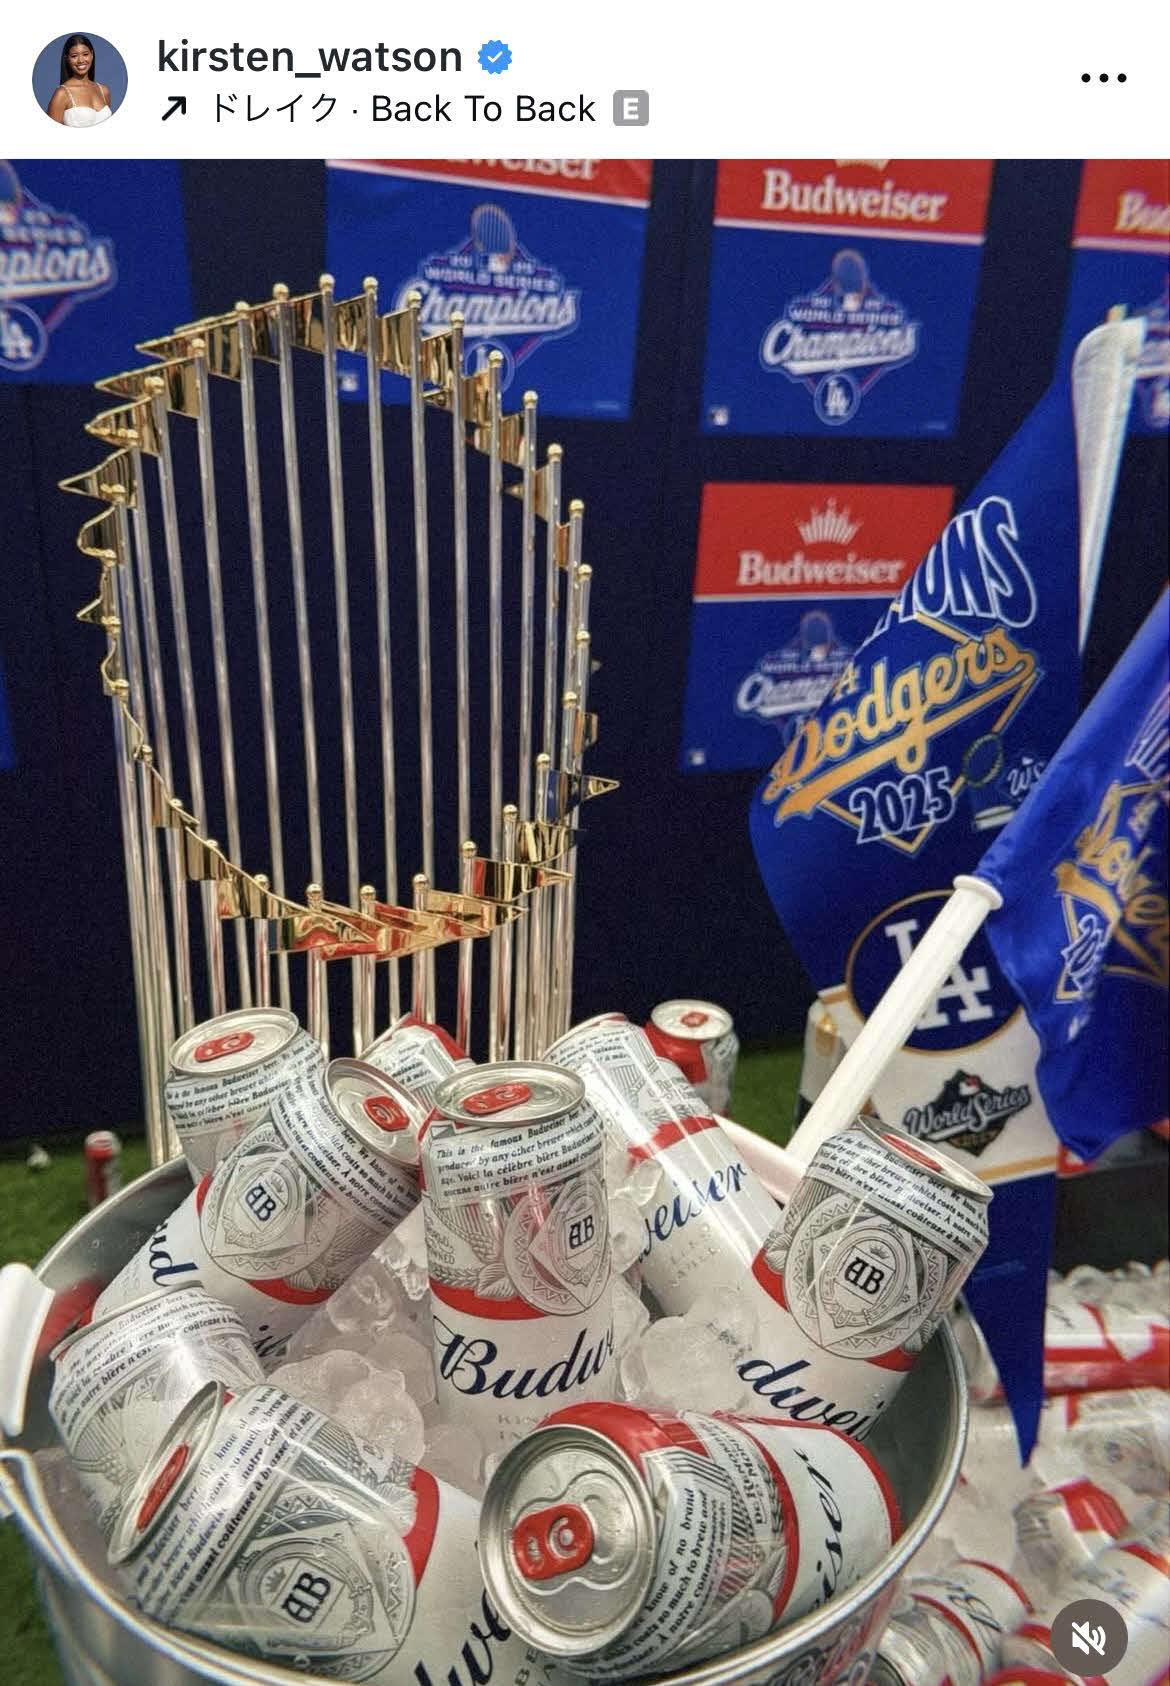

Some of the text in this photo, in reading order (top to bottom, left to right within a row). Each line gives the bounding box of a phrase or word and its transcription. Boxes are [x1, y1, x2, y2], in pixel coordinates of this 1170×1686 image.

[761, 167, 948, 222] Budweiser
[737, 551, 903, 586] Budweiser
[763, 627, 1035, 800] Dodgers
[848, 766, 957, 845] 2025
[222, 1068, 259, 1086] Budweiser
[903, 1087, 1029, 1137] World Series
[341, 1128, 356, 1148] beer.
[437, 1118, 565, 1159] This is the famous Budweiser
[479, 1156, 489, 1166] by
[492, 1153, 509, 1162] any
[511, 1144, 535, 1157] other
[536, 1133, 564, 1149] brewer
[308, 1151, 341, 1189] coûteuse
[342, 1148, 360, 1171] costs
[358, 1168, 368, 1178] so
[367, 1176, 386, 1195] much
[458, 1171, 480, 1181] Voici
[483, 1169, 493, 1177] la
[497, 1159, 533, 1175] célèbre
[536, 1150, 559, 1163] bière
[474, 1181, 500, 1191] autre
[503, 1174, 529, 1186] bière
[532, 1165, 554, 1178] n'est
[869, 1172, 892, 1188] bière
[245, 1183, 277, 1222] AB
[350, 1177, 370, 1197] notre
[881, 1165, 911, 1184] brewer
[912, 1183, 937, 1201] which
[937, 1198, 957, 1214] costs
[568, 1215, 595, 1250] AB
[905, 1207, 947, 1235] coûteuse
[844, 1257, 886, 1296] AB
[101, 1362, 126, 1386] bière
[183, 1317, 220, 1334] coûteuse
[214, 1433, 239, 1460] know
[240, 1429, 262, 1456] much
[241, 1447, 264, 1480] notre
[217, 1491, 257, 1549] coûteuse
[645, 1487, 695, 1612] know of no brand
[658, 1610, 671, 1624] so
[668, 1576, 692, 1610] much
[686, 1559, 698, 1575] to
[695, 1520, 708, 1559] brew
[281, 1572, 332, 1624] AB
[669, 1601, 695, 1634] notre
